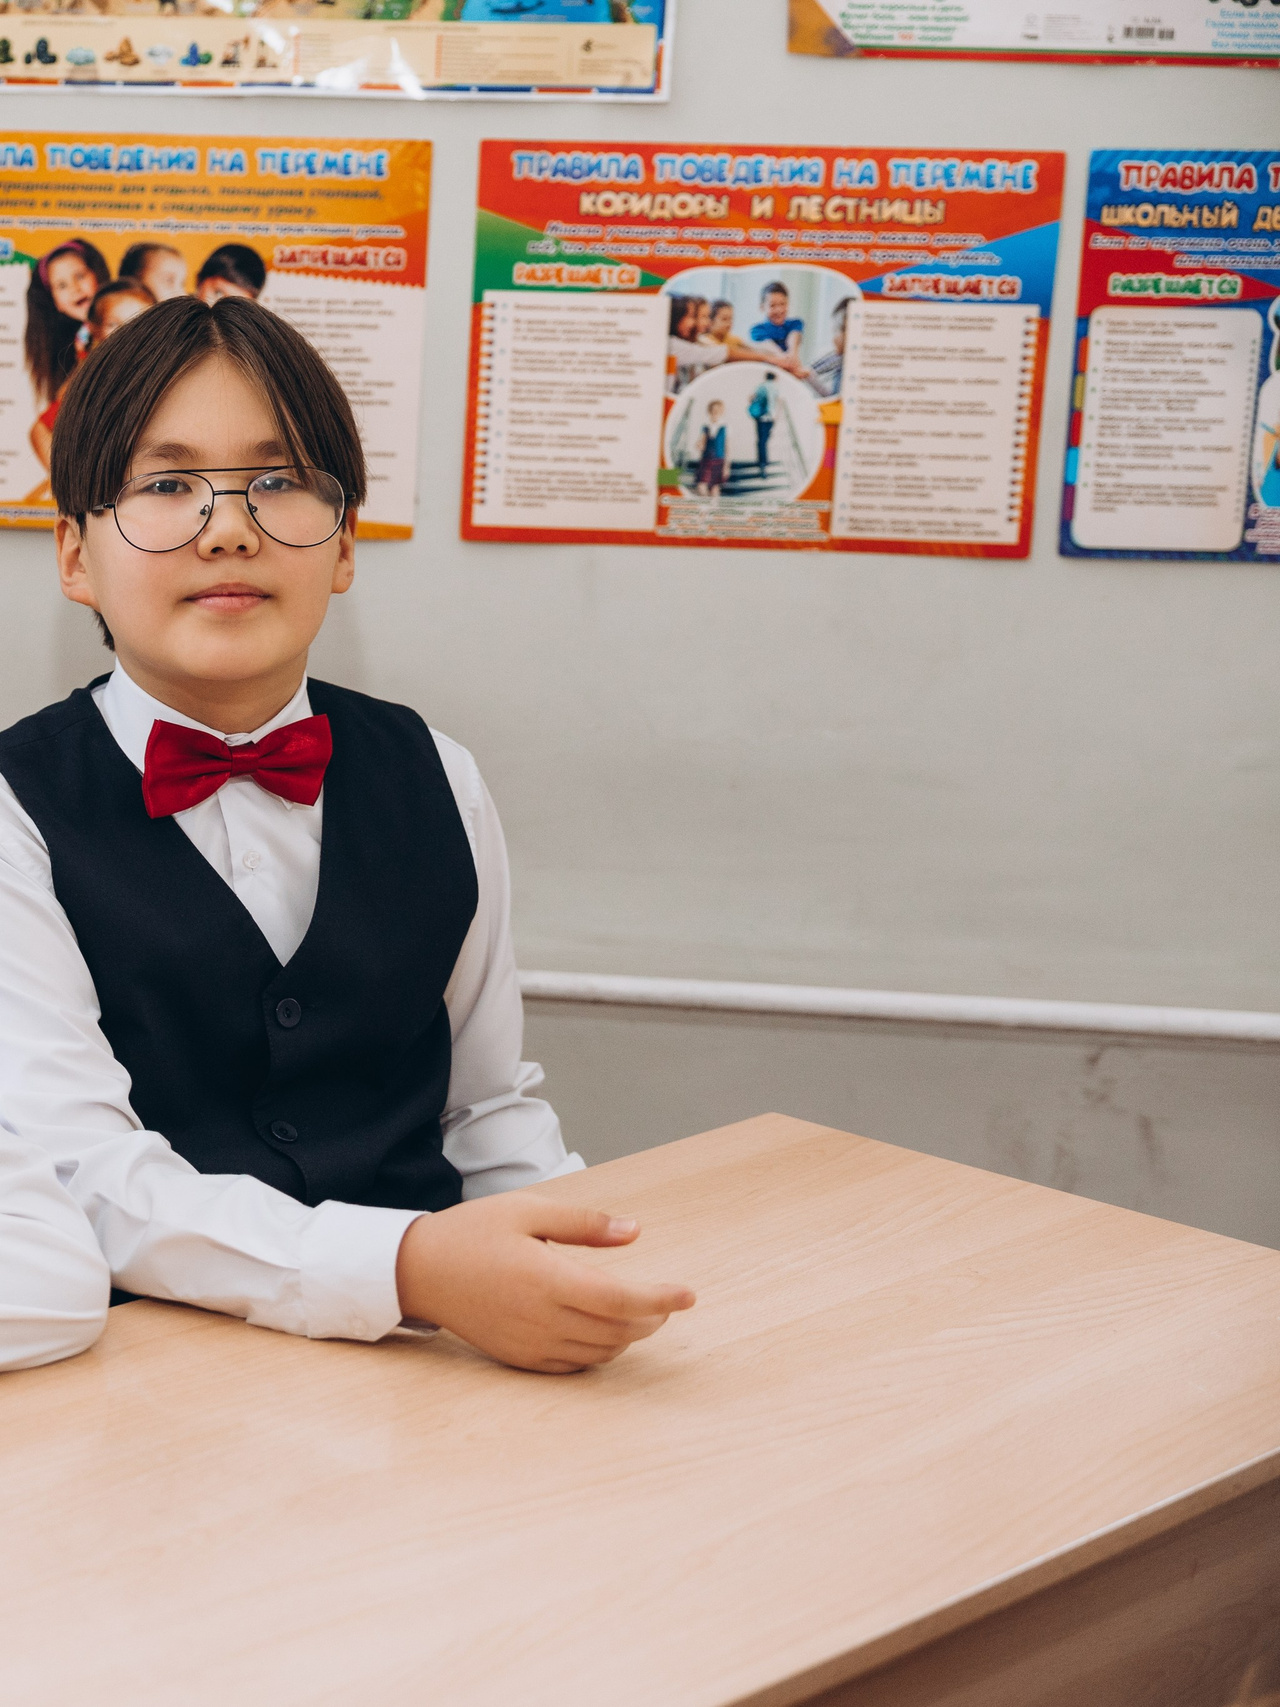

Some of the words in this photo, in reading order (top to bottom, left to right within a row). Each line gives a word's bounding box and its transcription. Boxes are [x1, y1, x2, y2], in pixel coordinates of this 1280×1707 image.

[46, 144, 197, 173] ПОВЕДЕНИЯ
[208, 148, 245, 175] НА
[258, 149, 389, 179] ПЕРЕМЕНЕ
[513, 153, 642, 182] ПРАВИЛА
[654, 156, 823, 186] ПОВЕДЕНИЯ
[834, 159, 877, 188] НА
[889, 160, 1037, 191] ПЕРЕМЕНЕ
[1120, 161, 1256, 192] ПРАВИЛА
[579, 192, 729, 221] КОРИДОРЫ
[750, 194, 773, 219] И
[786, 194, 946, 226] ЛЕСТНИЦЫ
[1101, 200, 1239, 229] ШКОЛЬНЫЙ
[276, 247, 405, 269] ЗАПРЕЩАЕТСЯ
[515, 263, 639, 287] РАЗРЕШАЕТСЯ
[885, 276, 1019, 298] ЗАПРЕЩАЕТСЯ
[1111, 275, 1240, 297] РАЗРЕШАЕТСЯ
